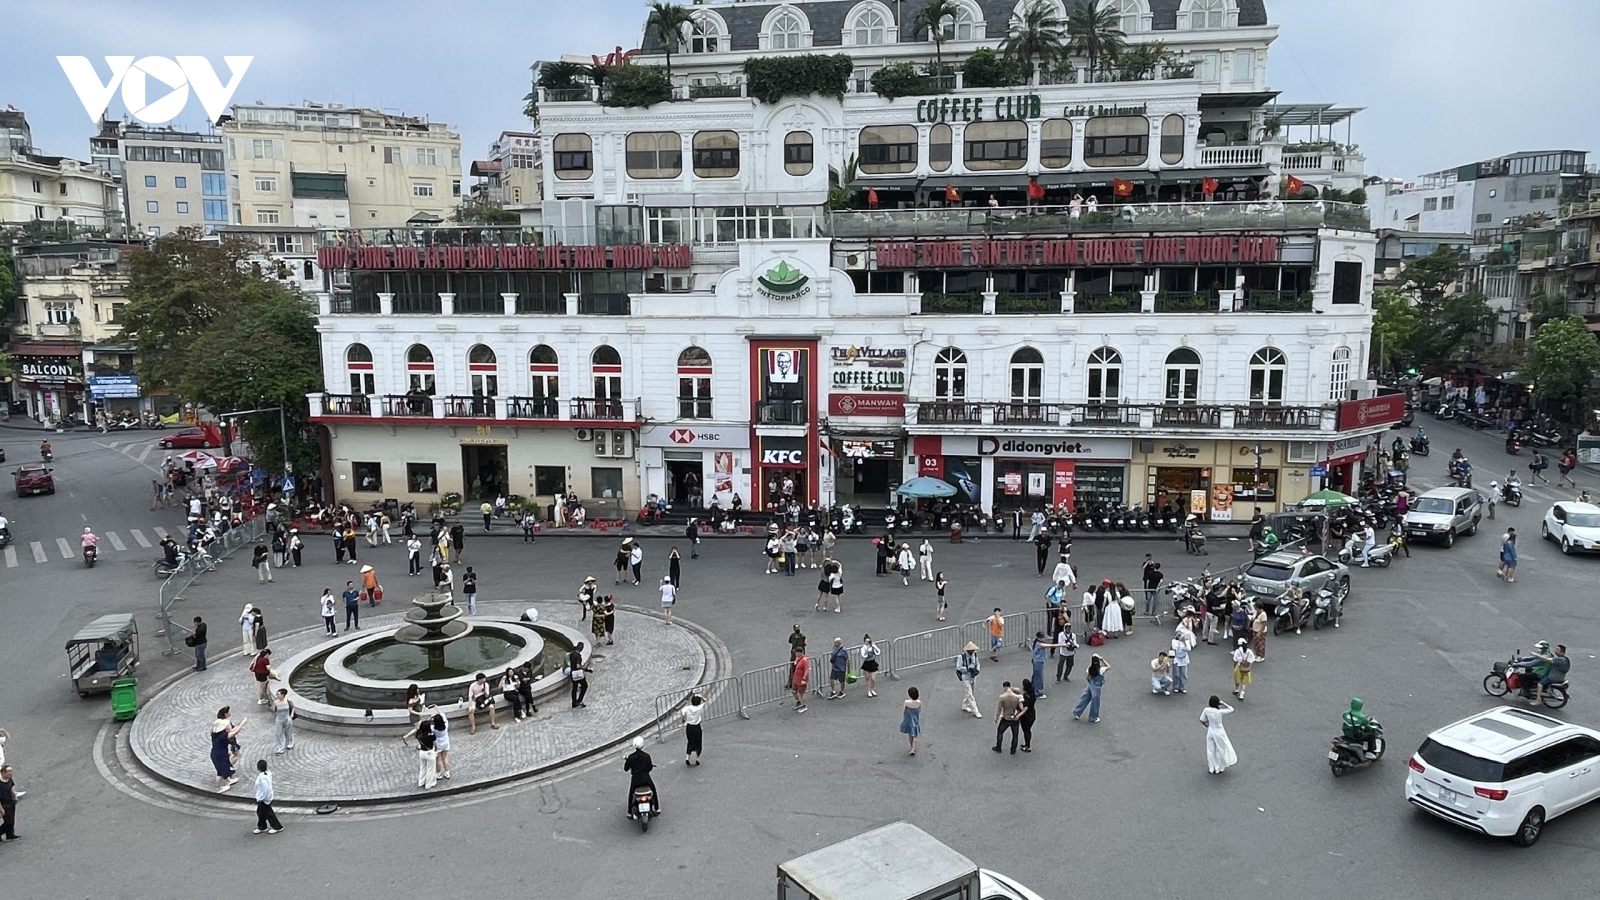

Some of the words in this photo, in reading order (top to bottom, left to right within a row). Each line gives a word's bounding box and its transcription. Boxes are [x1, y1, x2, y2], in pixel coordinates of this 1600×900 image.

[917, 97, 983, 123] COFFEE
[996, 94, 1041, 120] CLUB
[1088, 105, 1095, 116] &
[1098, 102, 1147, 116] Restaurant
[575, 245, 606, 268] NAM
[1043, 239, 1078, 265] NAM
[1143, 237, 1180, 263] VINH
[757, 287, 810, 301] PHYTOPHARCO
[22, 364, 73, 375] BALCONY
[833, 371, 873, 384] COFFEE
[877, 371, 904, 384] CLUB
[697, 433, 720, 441] HSBC
[762, 450, 802, 464] KFC
[925, 458, 937, 466] 03
